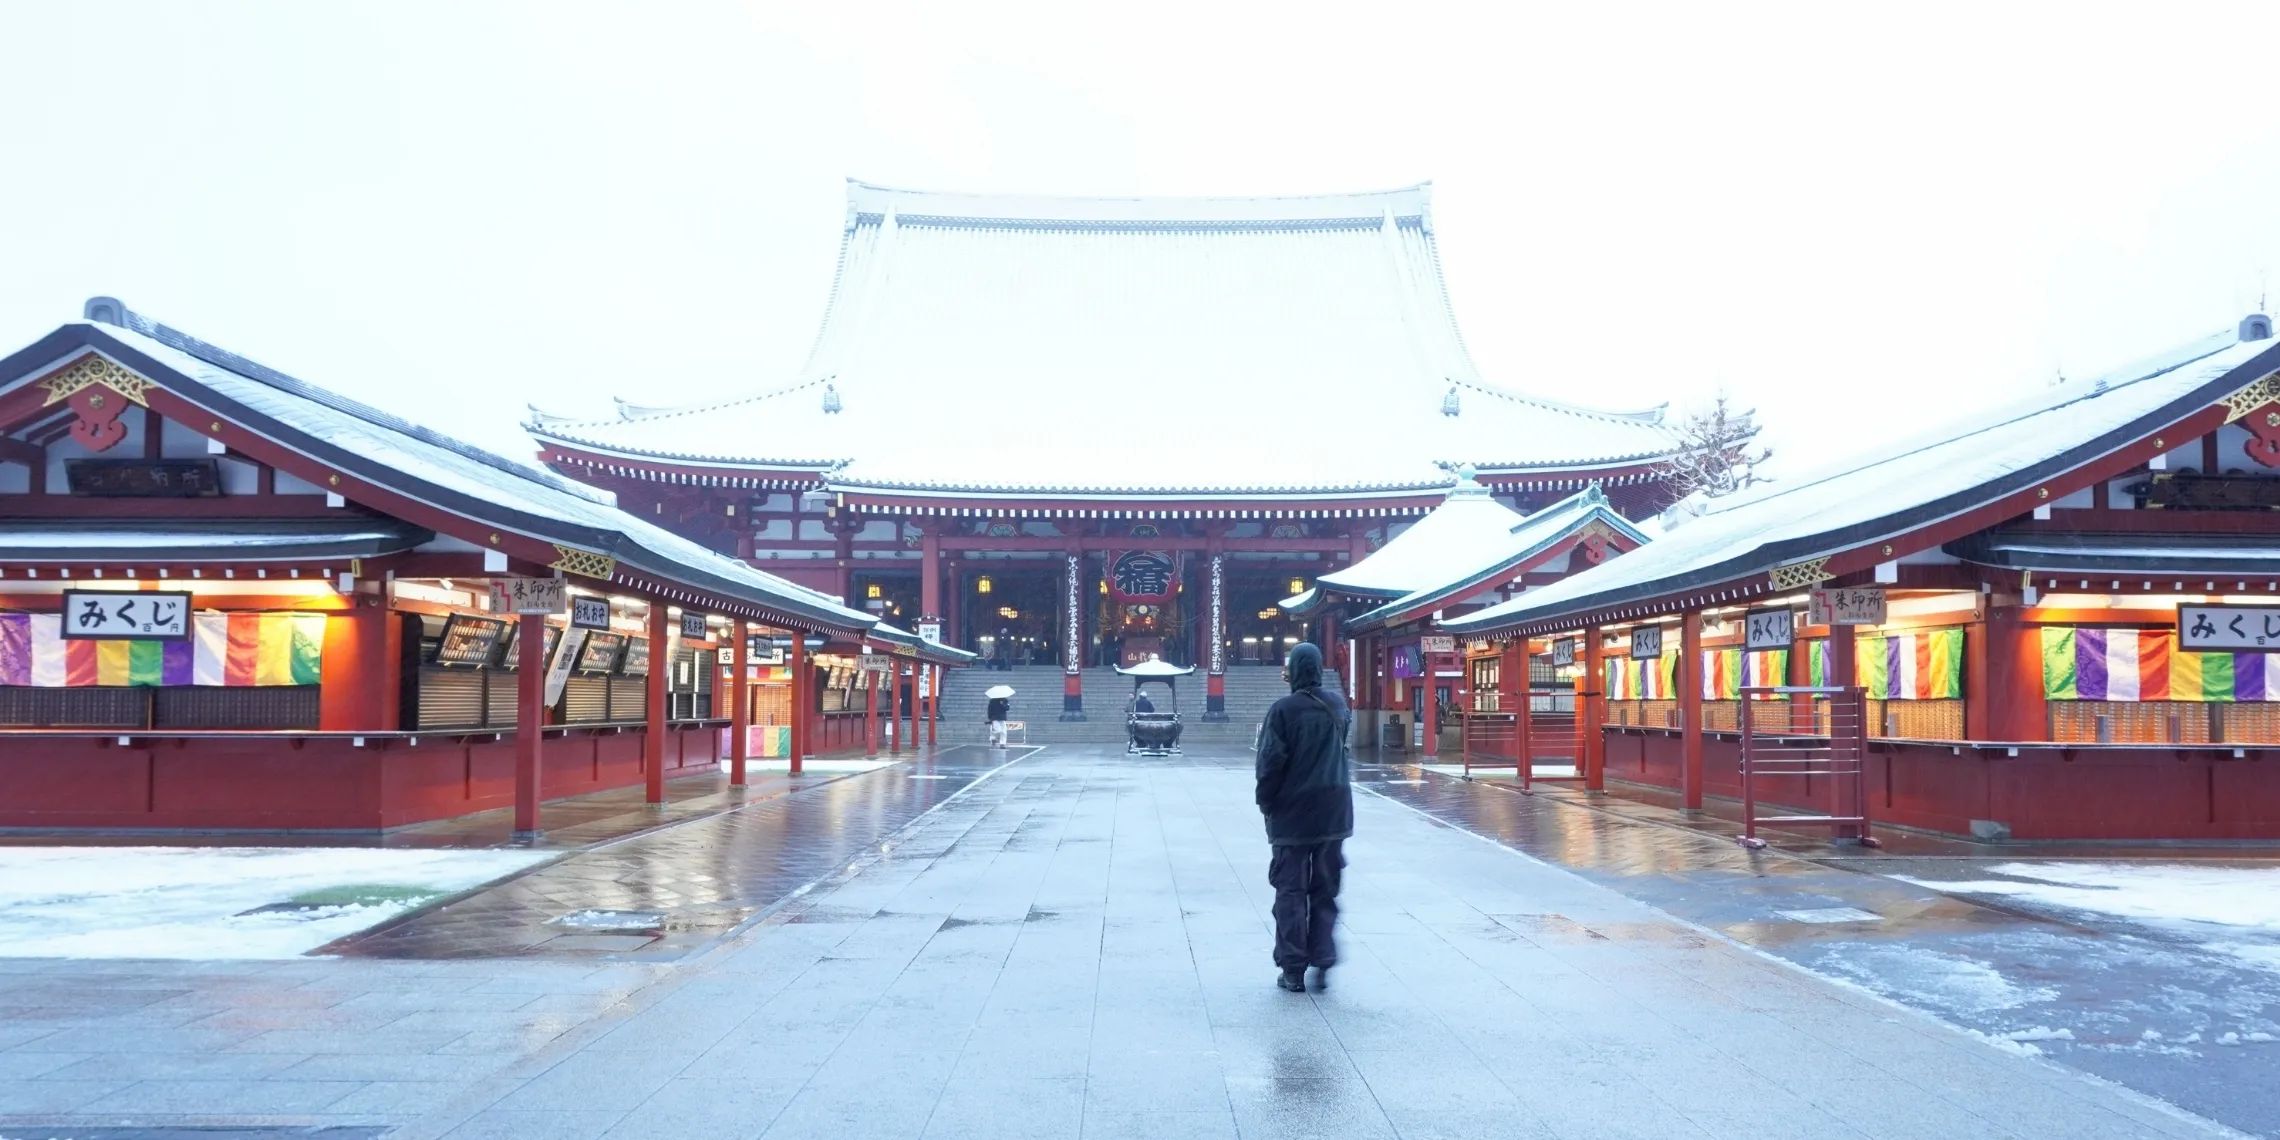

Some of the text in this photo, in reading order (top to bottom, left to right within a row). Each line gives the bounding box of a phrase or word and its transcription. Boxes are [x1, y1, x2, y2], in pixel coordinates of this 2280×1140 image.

[513, 580, 563, 601] 朱印所
[1835, 591, 1882, 611] 朱印所
[79, 599, 176, 628] みくじ
[576, 603, 605, 623] お札お守
[1752, 615, 1788, 642] みくじ
[1555, 643, 1572, 661] みくじ
[1636, 631, 1658, 652] みくじ
